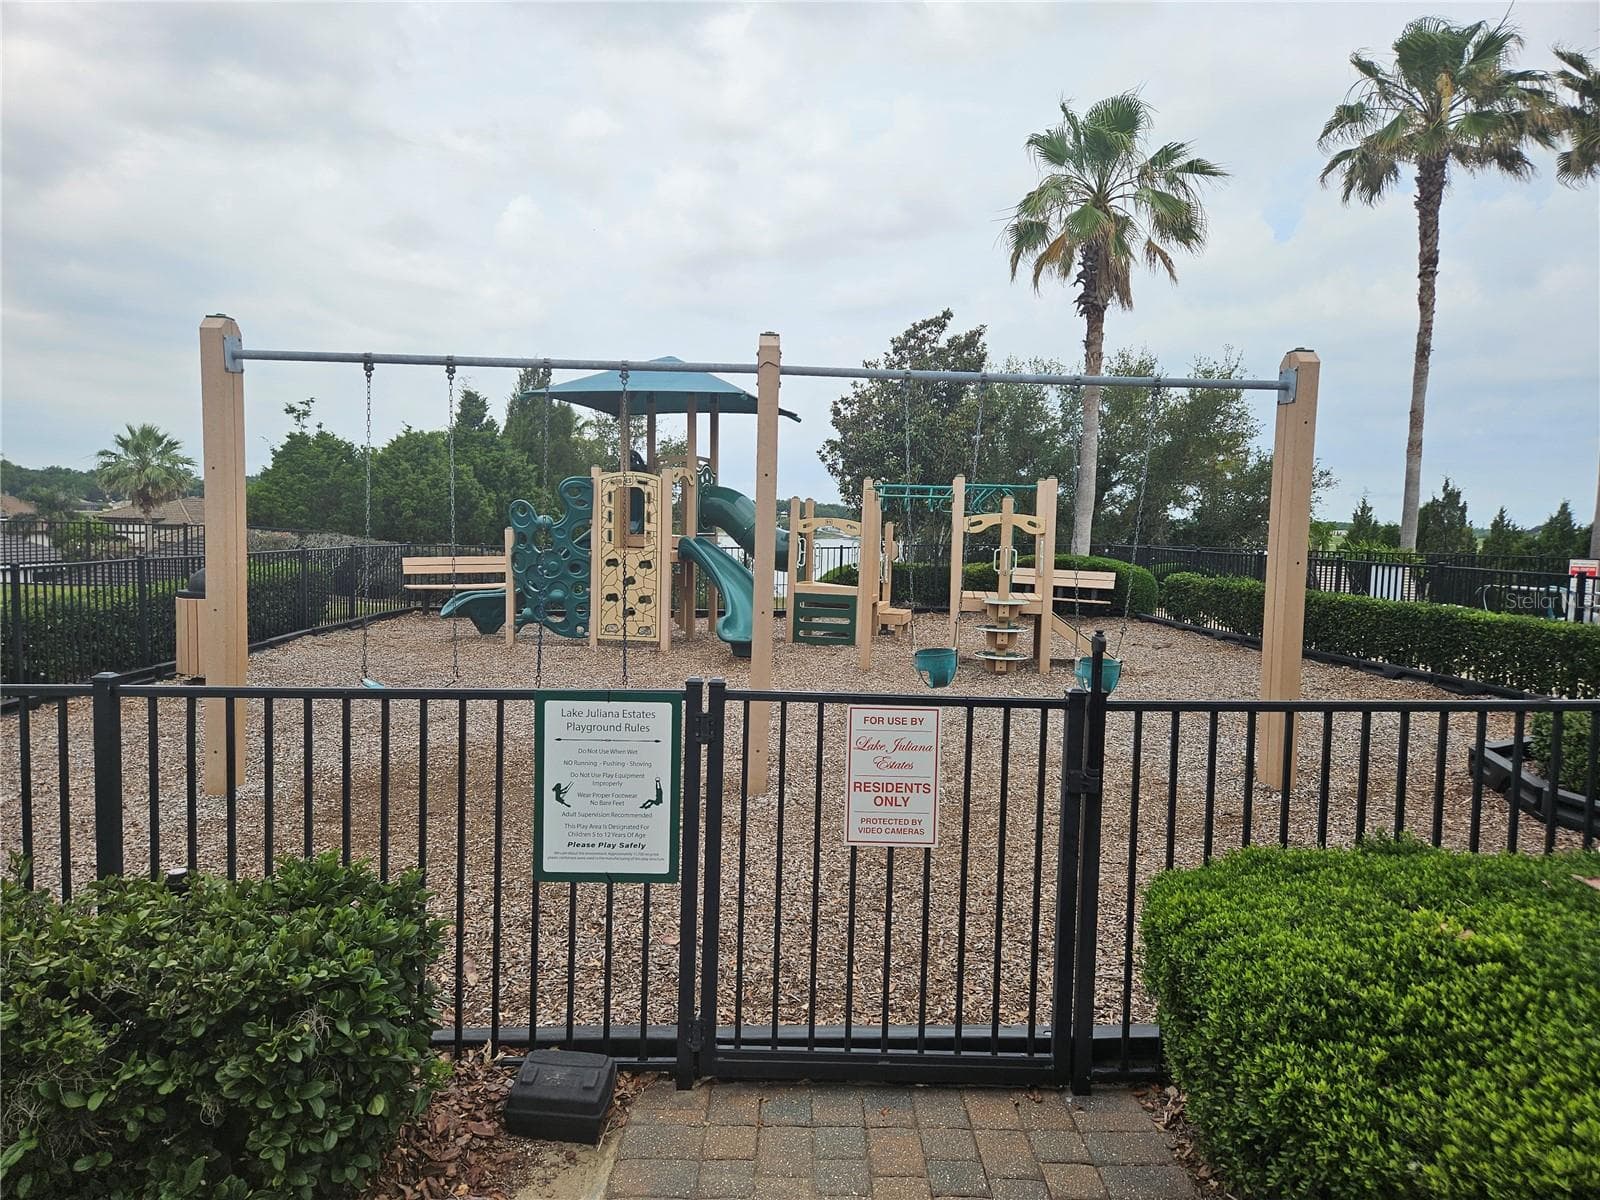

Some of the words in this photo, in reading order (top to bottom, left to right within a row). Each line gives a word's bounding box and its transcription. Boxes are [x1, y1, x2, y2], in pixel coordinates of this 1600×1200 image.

[561, 708, 583, 718] Lake
[586, 708, 620, 718] Juliana
[622, 709, 656, 718] Estates
[864, 716, 885, 725] FOR
[887, 717, 908, 726] USE
[910, 717, 924, 726] BY
[566, 722, 622, 733] Playground
[624, 723, 650, 732] Rules
[854, 736, 886, 752] Lake
[886, 737, 934, 754] Juliana
[873, 756, 914, 770] Estates
[853, 782, 931, 794] RESIDENTS
[874, 796, 910, 807] ONLY
[860, 818, 909, 826] PROTECTED
[598, 841, 616, 850] Play
[619, 842, 646, 850] Safely
